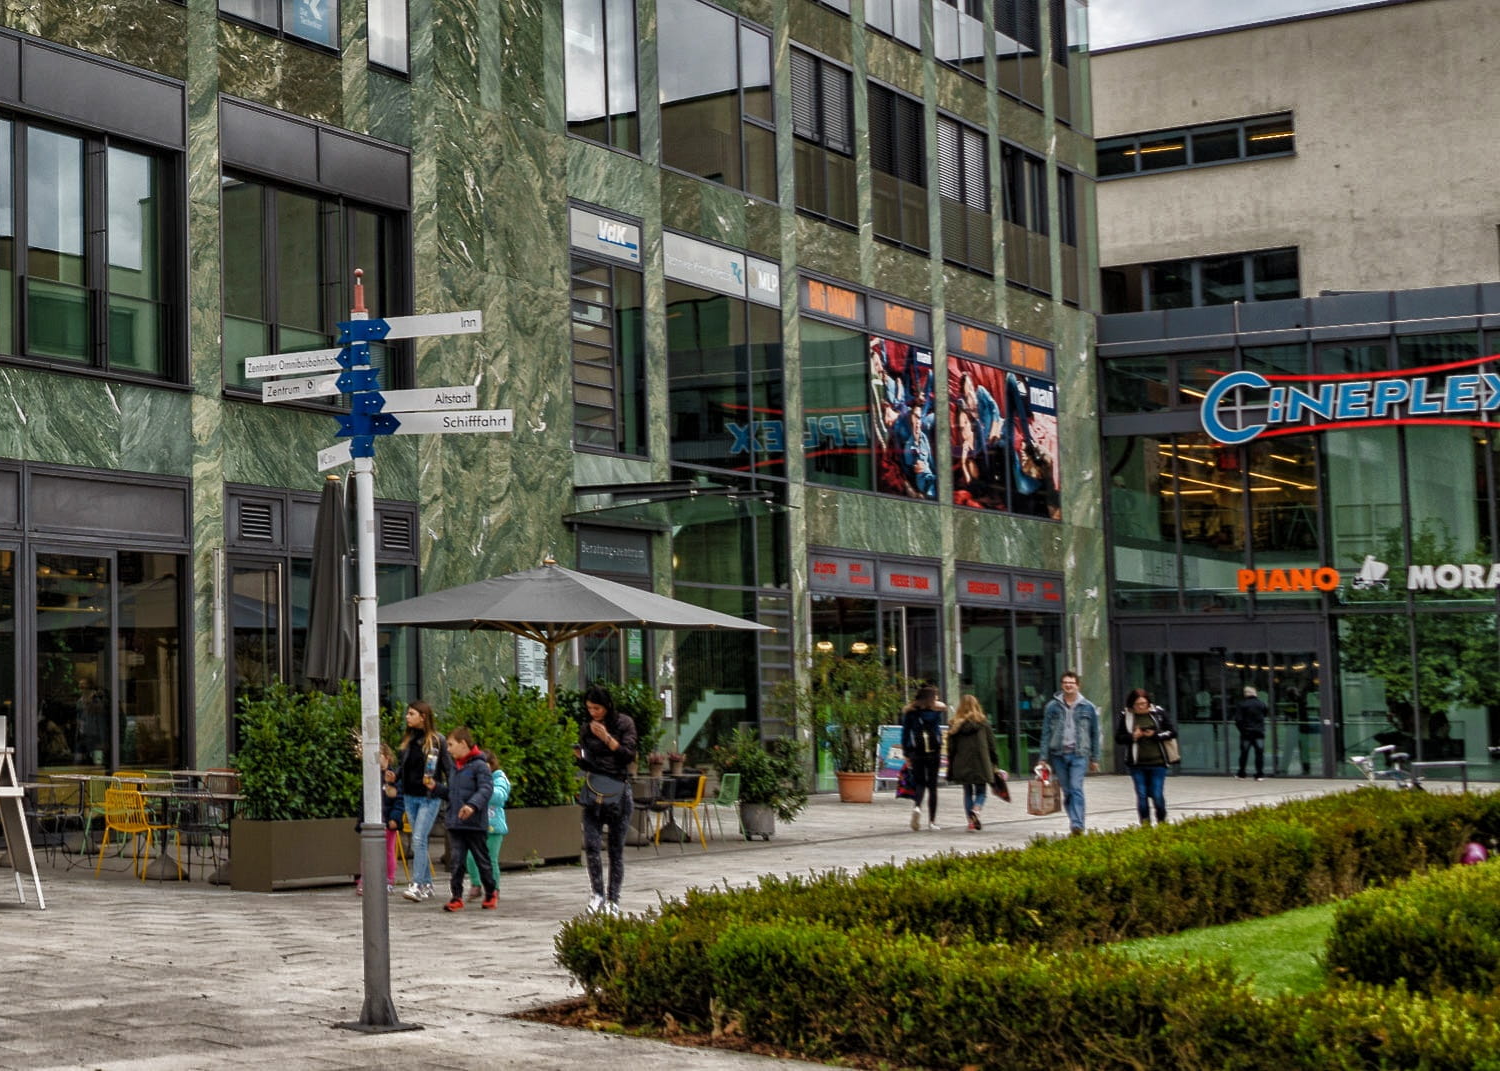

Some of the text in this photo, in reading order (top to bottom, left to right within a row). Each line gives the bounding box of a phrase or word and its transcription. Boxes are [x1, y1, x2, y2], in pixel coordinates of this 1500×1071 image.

[598, 219, 627, 245] VdK
[758, 269, 778, 293] MLP
[460, 317, 477, 328] Inn
[247, 361, 278, 373] Zentraler
[267, 385, 300, 397] Zentrum
[435, 392, 471, 405] Altstadt
[443, 415, 507, 428] Schifffahrt
[1237, 563, 1500, 592] PIANO MORA
